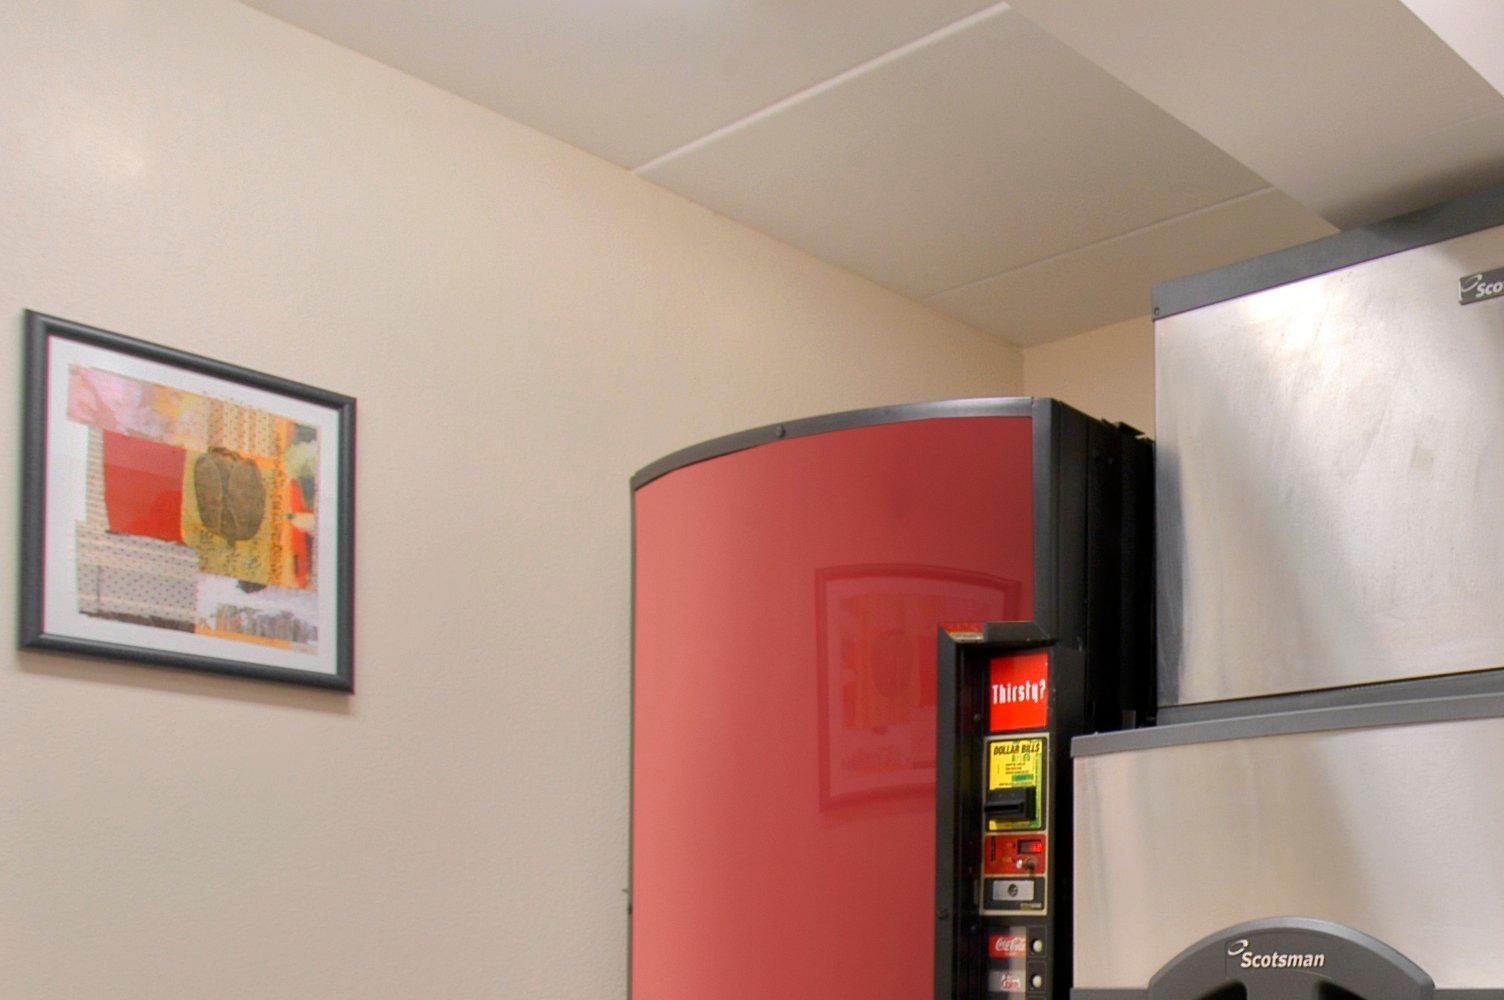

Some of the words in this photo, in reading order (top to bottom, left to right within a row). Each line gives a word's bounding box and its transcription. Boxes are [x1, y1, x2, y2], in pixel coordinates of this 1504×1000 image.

[992, 679, 1046, 705] Thirsty?
[994, 744, 1020, 756] DOLLAR
[1021, 743, 1040, 754] BILLS
[1240, 952, 1325, 968] Scotsman
